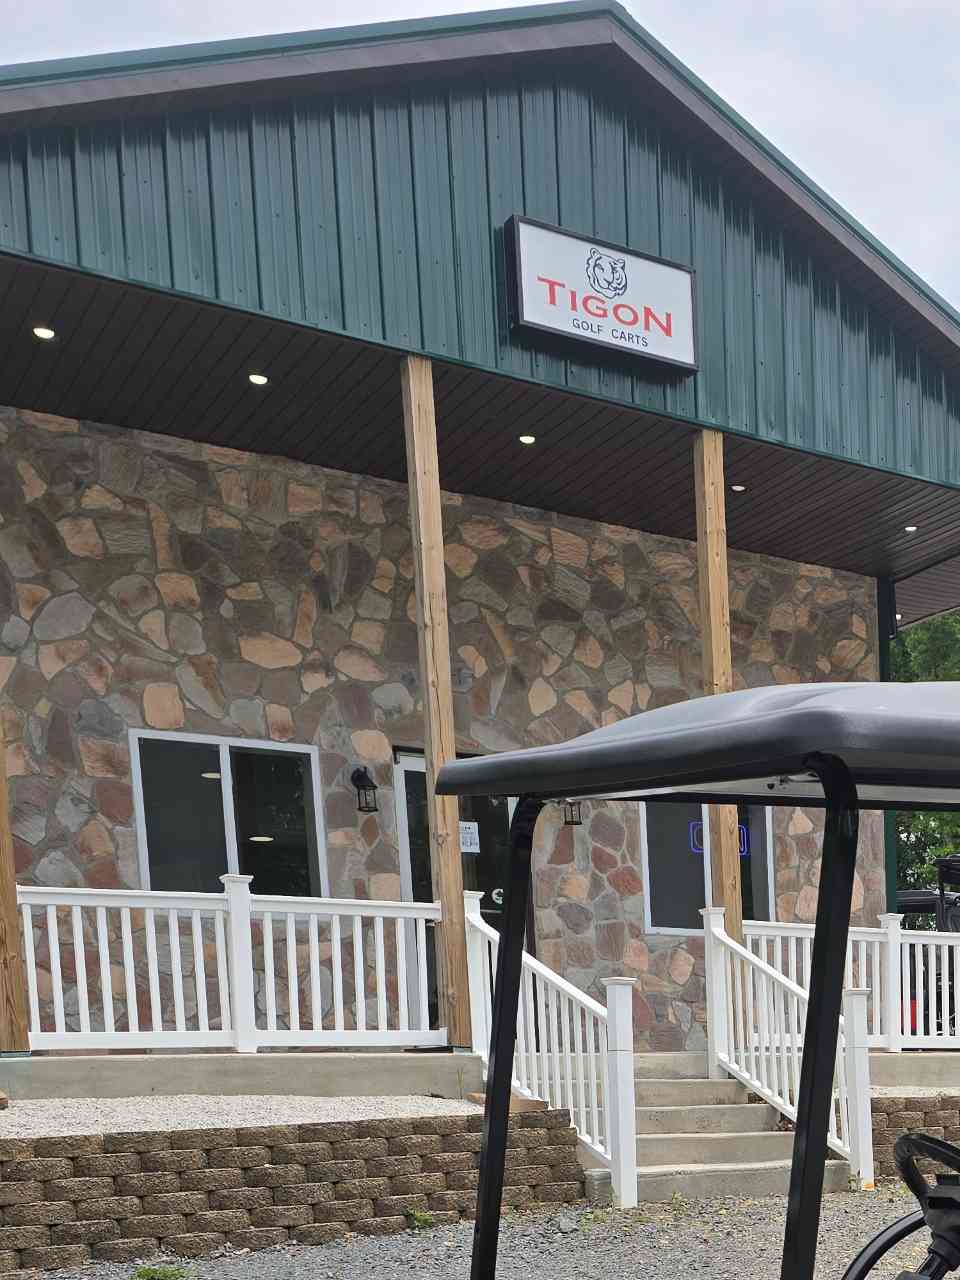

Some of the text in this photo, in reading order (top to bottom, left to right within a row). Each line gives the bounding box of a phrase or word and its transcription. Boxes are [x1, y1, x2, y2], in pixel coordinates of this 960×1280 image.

[537, 276, 672, 337] TIGON
[572, 318, 649, 347] GOLF CARTS
